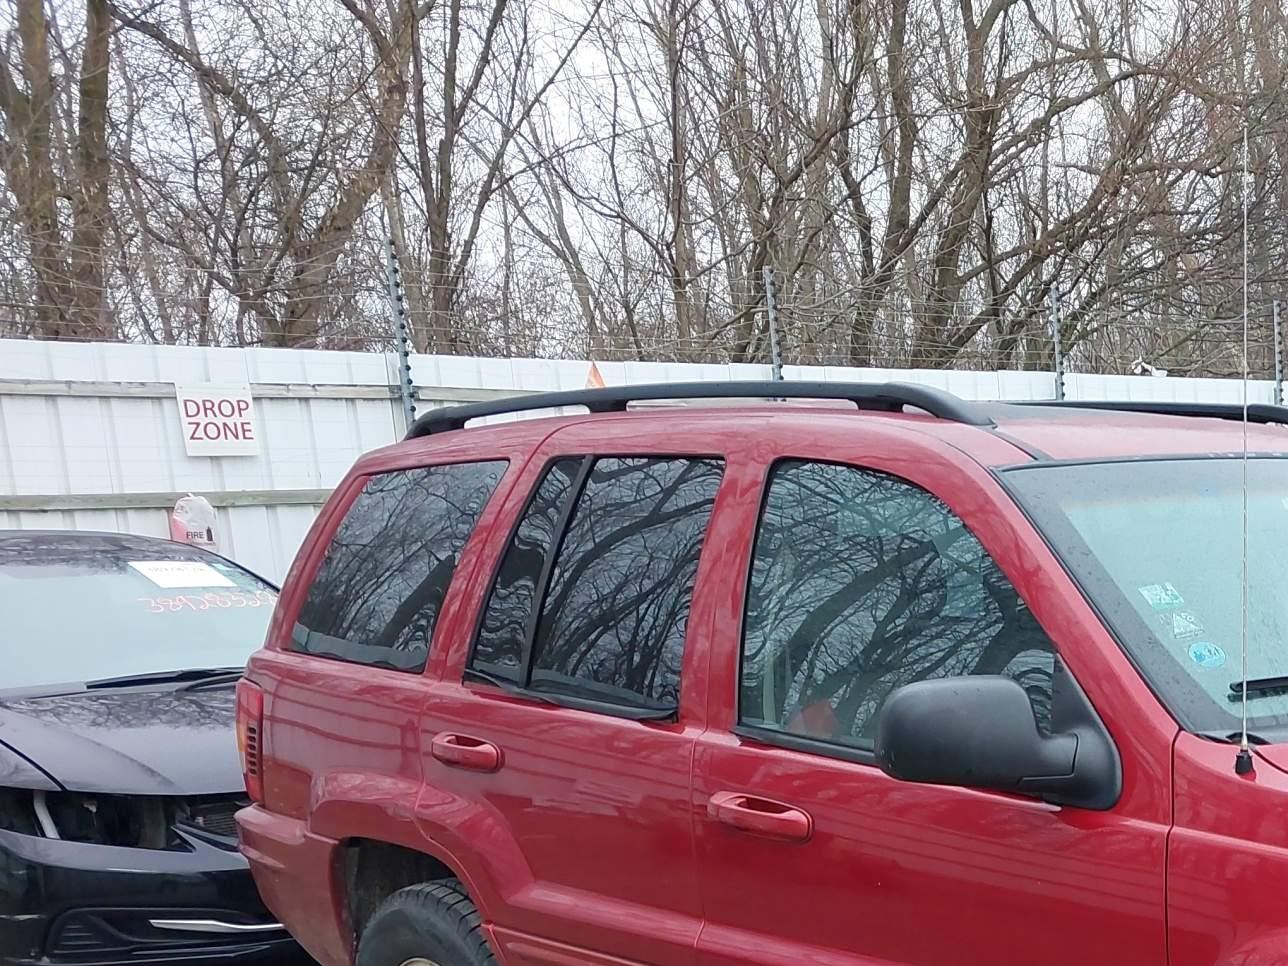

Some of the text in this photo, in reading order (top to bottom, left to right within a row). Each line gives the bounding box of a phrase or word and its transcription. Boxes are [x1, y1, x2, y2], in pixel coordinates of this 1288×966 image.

[183, 399, 249, 418] DROP
[187, 421, 254, 441] ZONE
[185, 531, 205, 540] FIRE
